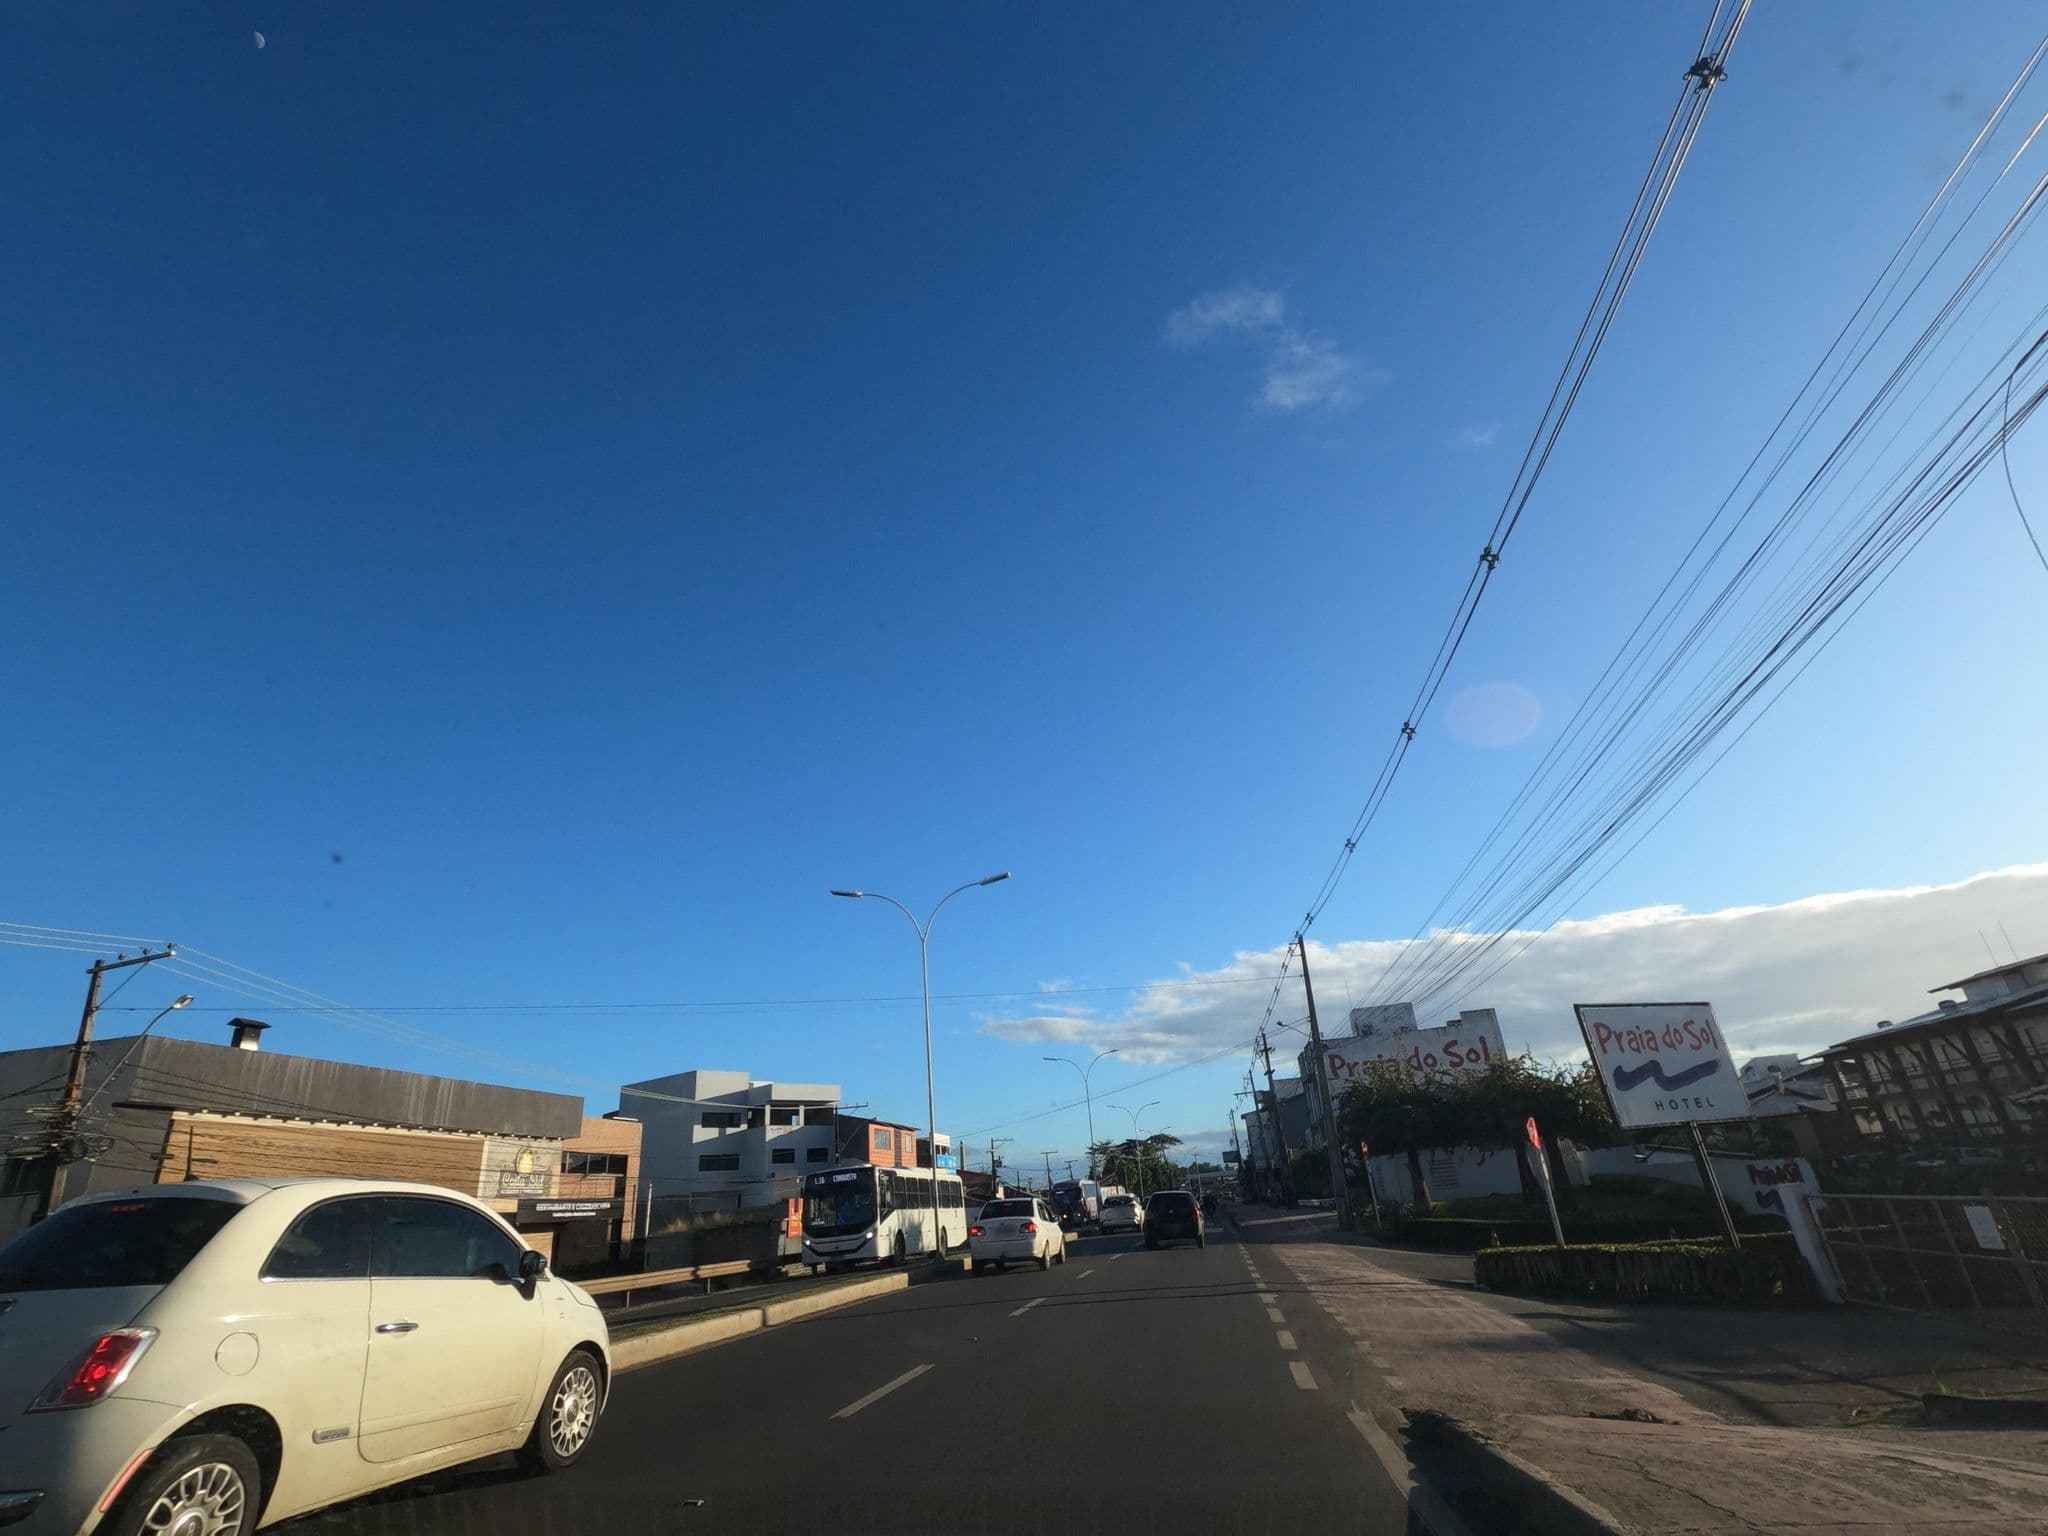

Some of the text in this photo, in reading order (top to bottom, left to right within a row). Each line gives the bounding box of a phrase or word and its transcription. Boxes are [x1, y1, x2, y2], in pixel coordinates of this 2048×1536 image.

[1407, 1046, 1438, 1072] do
[1443, 1035, 1491, 1068] Sol
[1593, 1019, 1719, 1054] Praia do Sol
[1655, 1097, 1715, 1112] HOTEL
